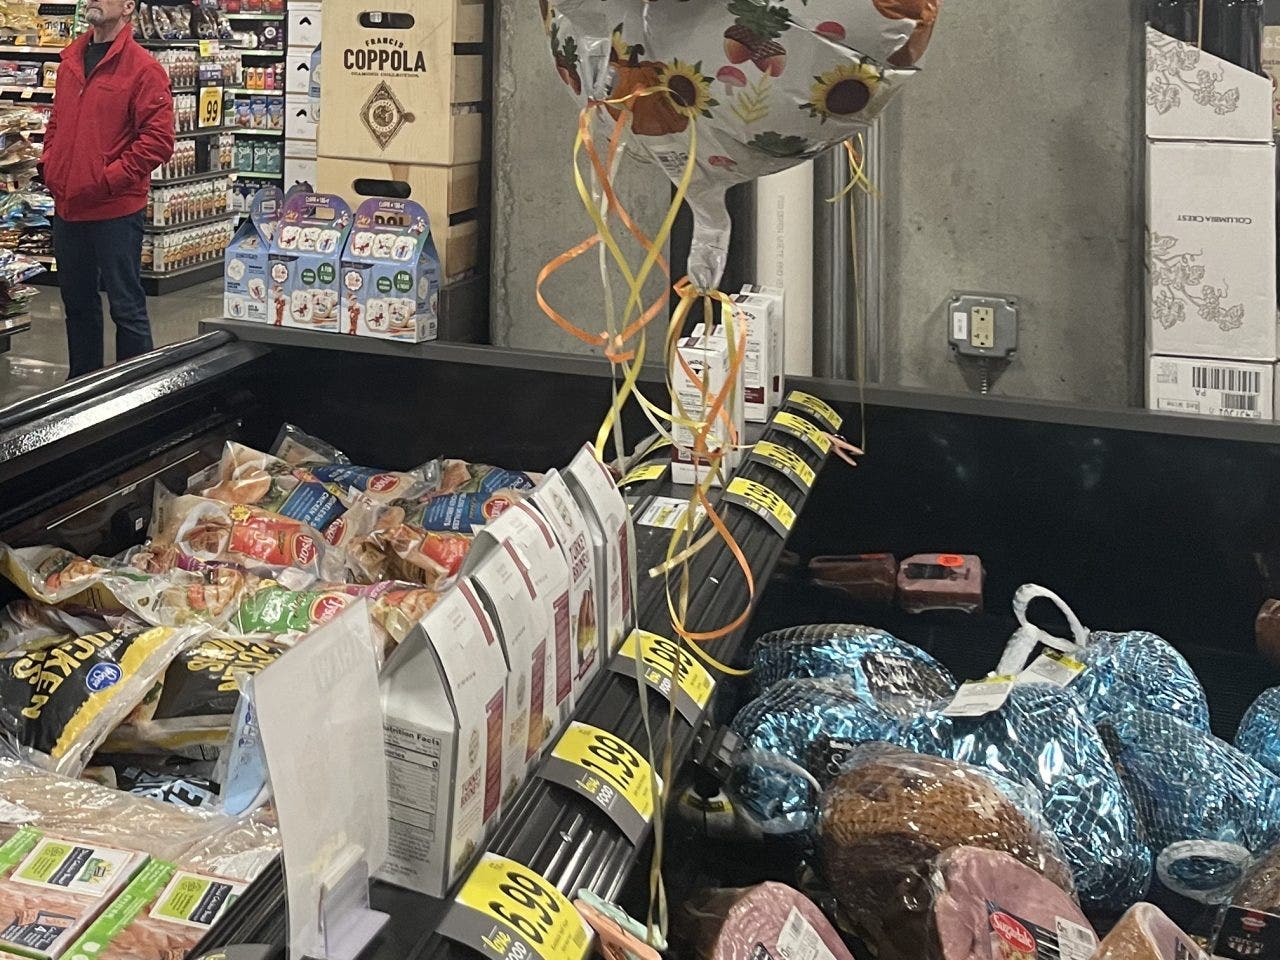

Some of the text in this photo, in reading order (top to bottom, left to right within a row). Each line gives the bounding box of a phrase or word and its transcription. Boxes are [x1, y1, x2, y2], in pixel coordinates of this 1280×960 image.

[365, 37, 404, 49] FRANCIS
[344, 49, 426, 72] COPPOLA
[203, 101, 218, 122] .99
[1177, 214, 1252, 224] COLUMBIA CREST
[416, 733, 440, 746] Facts
[581, 734, 640, 792] 1.99
[596, 784, 615, 807] FOOD
[488, 871, 560, 944] 6.99
